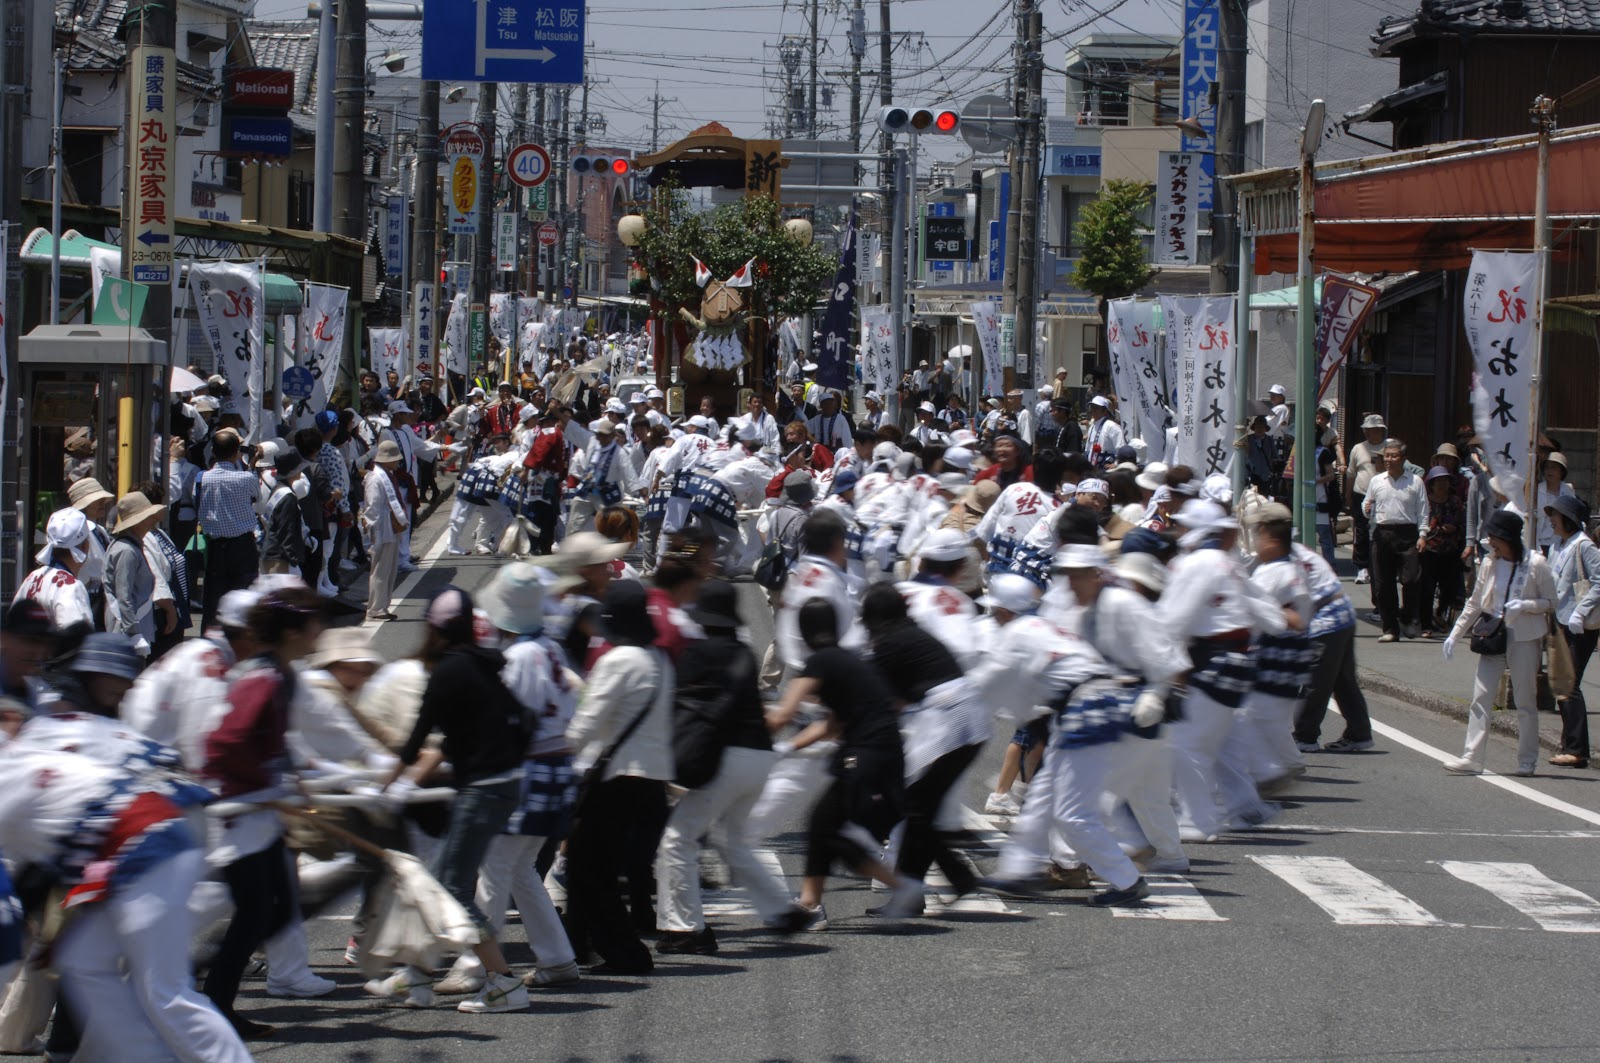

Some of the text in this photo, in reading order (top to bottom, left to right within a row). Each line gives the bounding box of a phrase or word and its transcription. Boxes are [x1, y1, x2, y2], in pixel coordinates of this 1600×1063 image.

[497, 8, 518, 27] 津
[535, 8, 579, 28] 松阪
[497, 29, 518, 40] Tsu
[534, 30, 579, 42] Matsusaka
[146, 55, 164, 112] 藤家具
[235, 82, 288, 95] National
[1186, 0, 1219, 209] 名大進学会
[233, 131, 288, 144] Panasonic
[517, 156, 541, 175] 40
[1169, 155, 1192, 165] 専門
[139, 118, 167, 225] 丸京家具
[747, 151, 781, 197] 新
[457, 164, 473, 210] カクテル
[1169, 166, 1189, 253] メガネのワキタ
[132, 251, 172, 262] 23-0676
